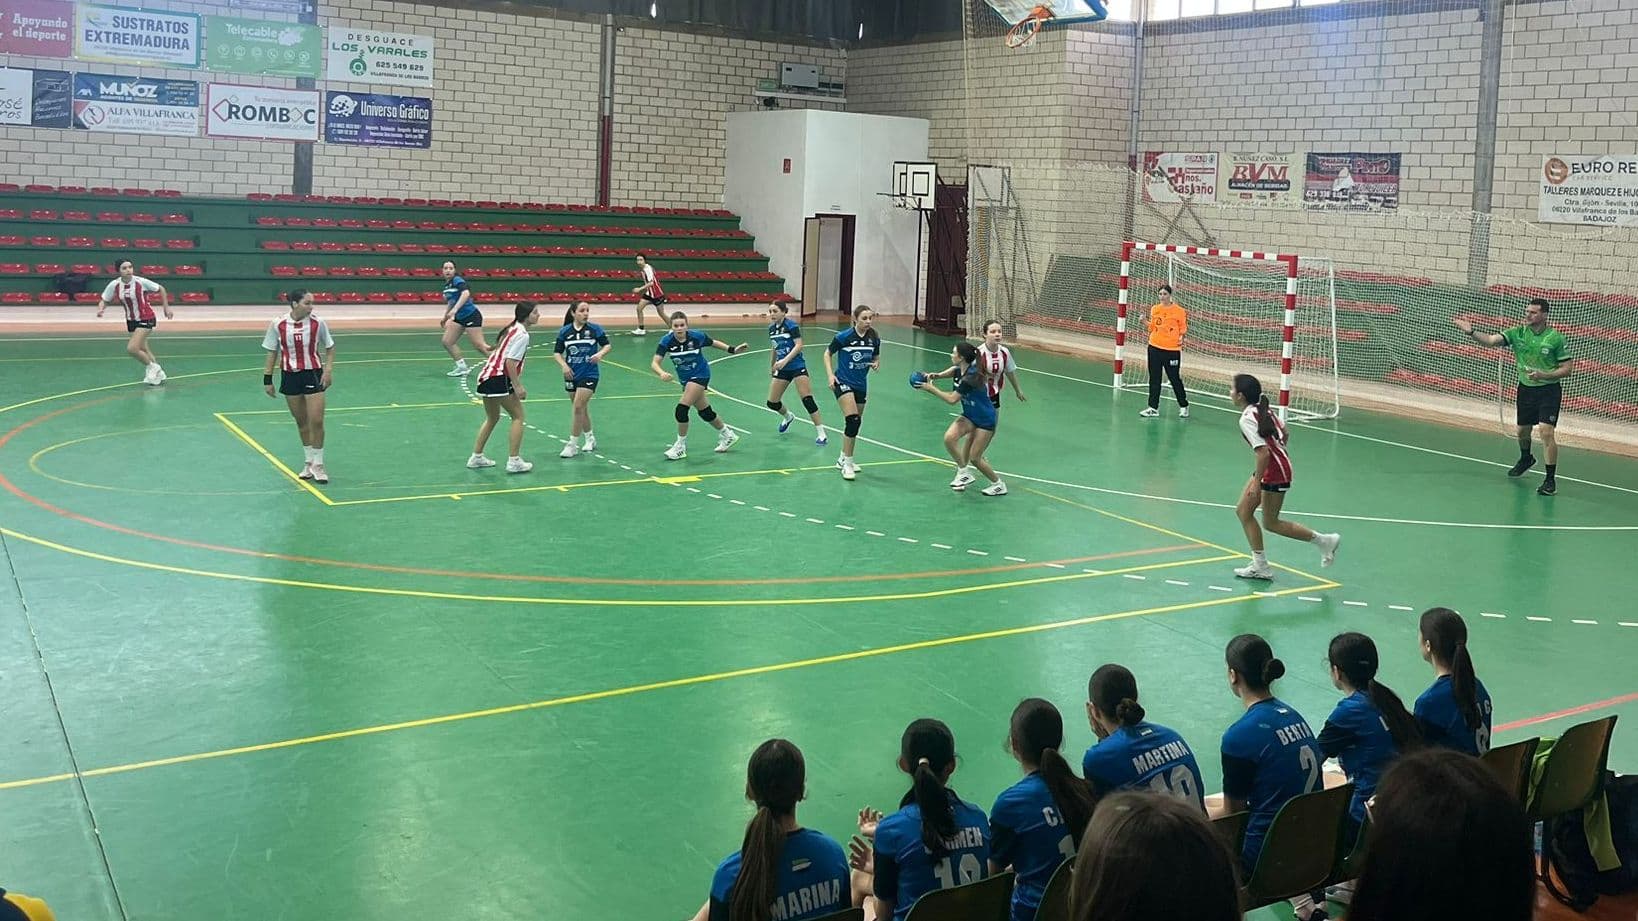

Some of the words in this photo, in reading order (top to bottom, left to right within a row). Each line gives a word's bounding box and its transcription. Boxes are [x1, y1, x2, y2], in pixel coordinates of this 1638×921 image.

[112, 15, 189, 34] SUSTRATOS
[225, 23, 277, 38] Telecable
[13, 26, 22, 37] el
[25, 28, 66, 41] deporte
[85, 29, 190, 50] EXTREMADURA
[347, 33, 414, 46] DESGUACE
[331, 42, 359, 52] LOS
[367, 45, 428, 59] VARALES
[100, 81, 158, 98] MUÑOZ
[107, 106, 131, 116] ALFA
[132, 108, 196, 120] VILLAFRANCA
[360, 100, 398, 118] Universo
[399, 103, 429, 121] Gráfico
[1571, 161, 1614, 174] EURO
[1617, 162, 1638, 174] RE
[1543, 185, 1579, 196] TALLERES
[1580, 187, 1616, 197] MARQUEZ
[1617, 188, 1622, 197] E
[1583, 215, 1617, 223] BADAJOZ
[1132, 740, 1190, 775] MARTINA
[771, 879, 840, 921] MARINA
